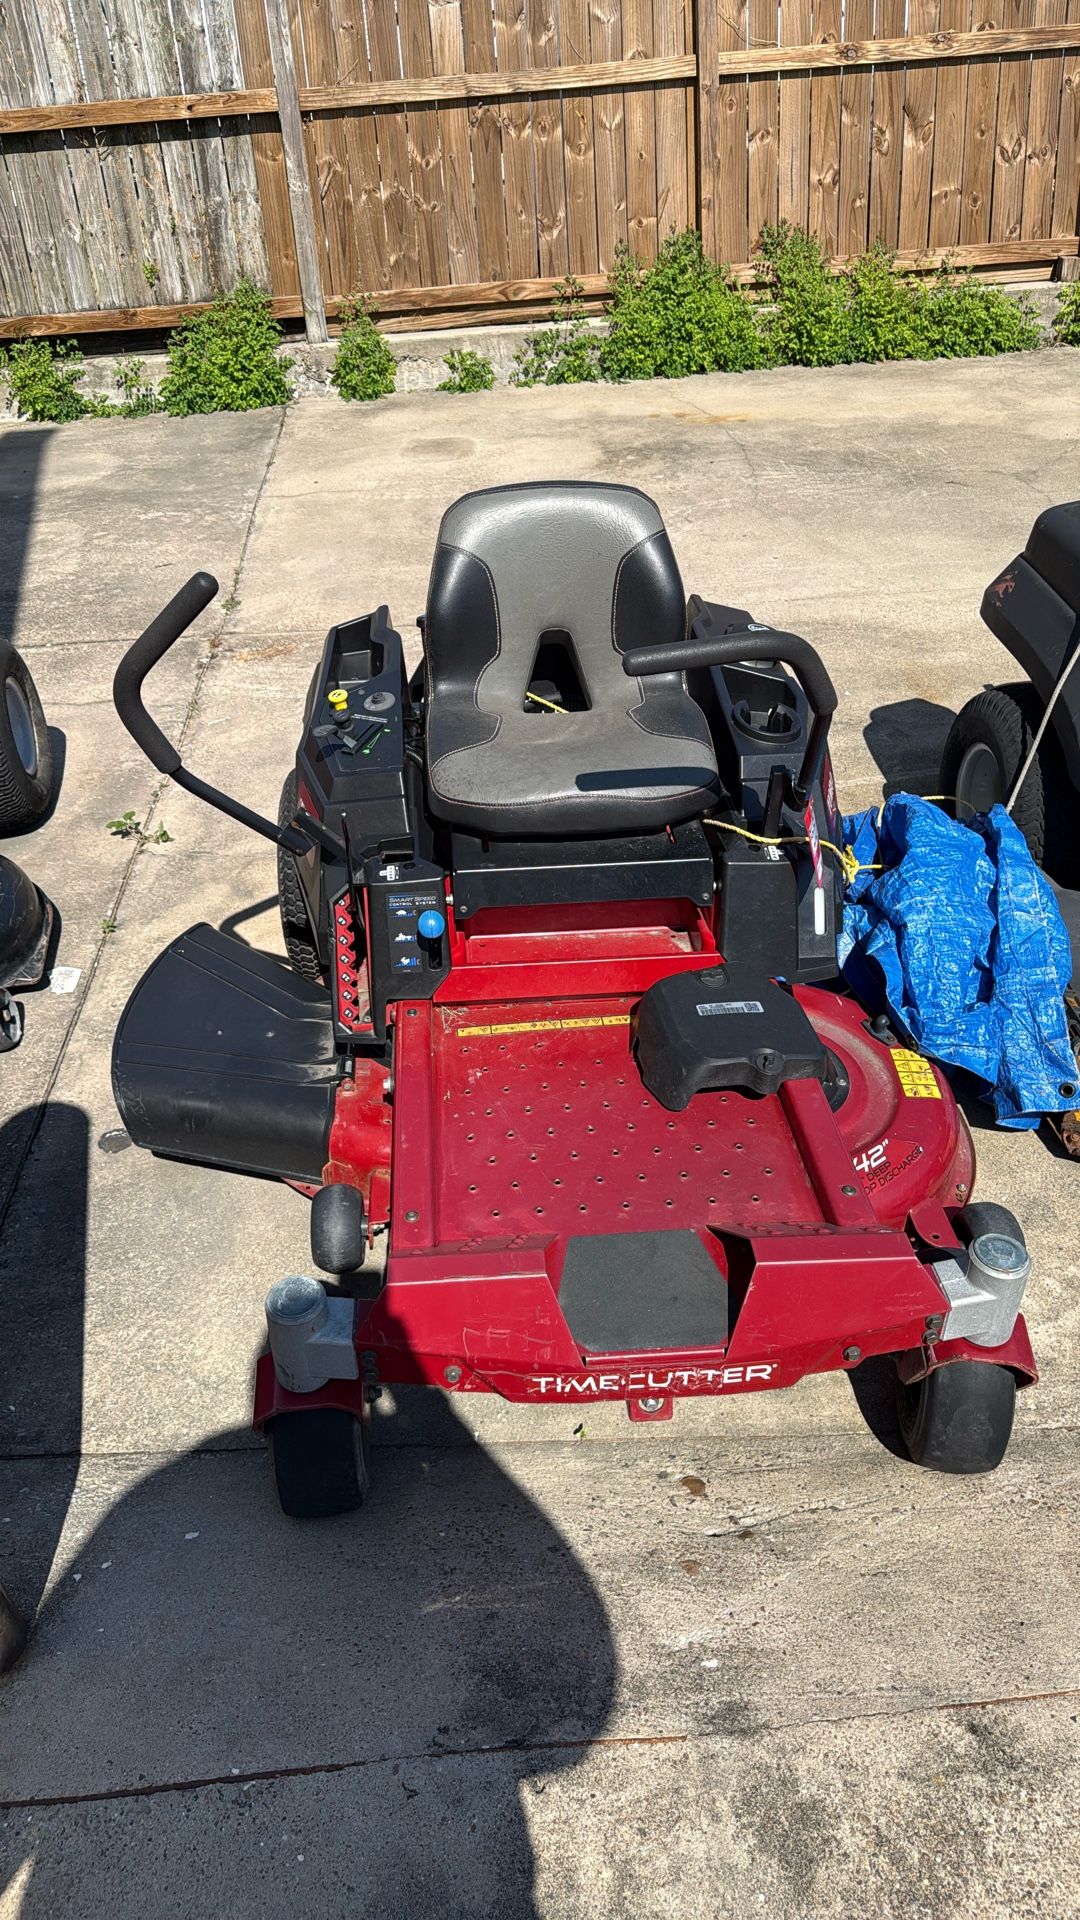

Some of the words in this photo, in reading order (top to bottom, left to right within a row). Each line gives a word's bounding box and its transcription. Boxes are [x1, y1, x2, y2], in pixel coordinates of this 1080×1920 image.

[853, 1138, 889, 1172] 42"
[866, 1161, 891, 1181] DEEP
[864, 1182, 877, 1195] OP
